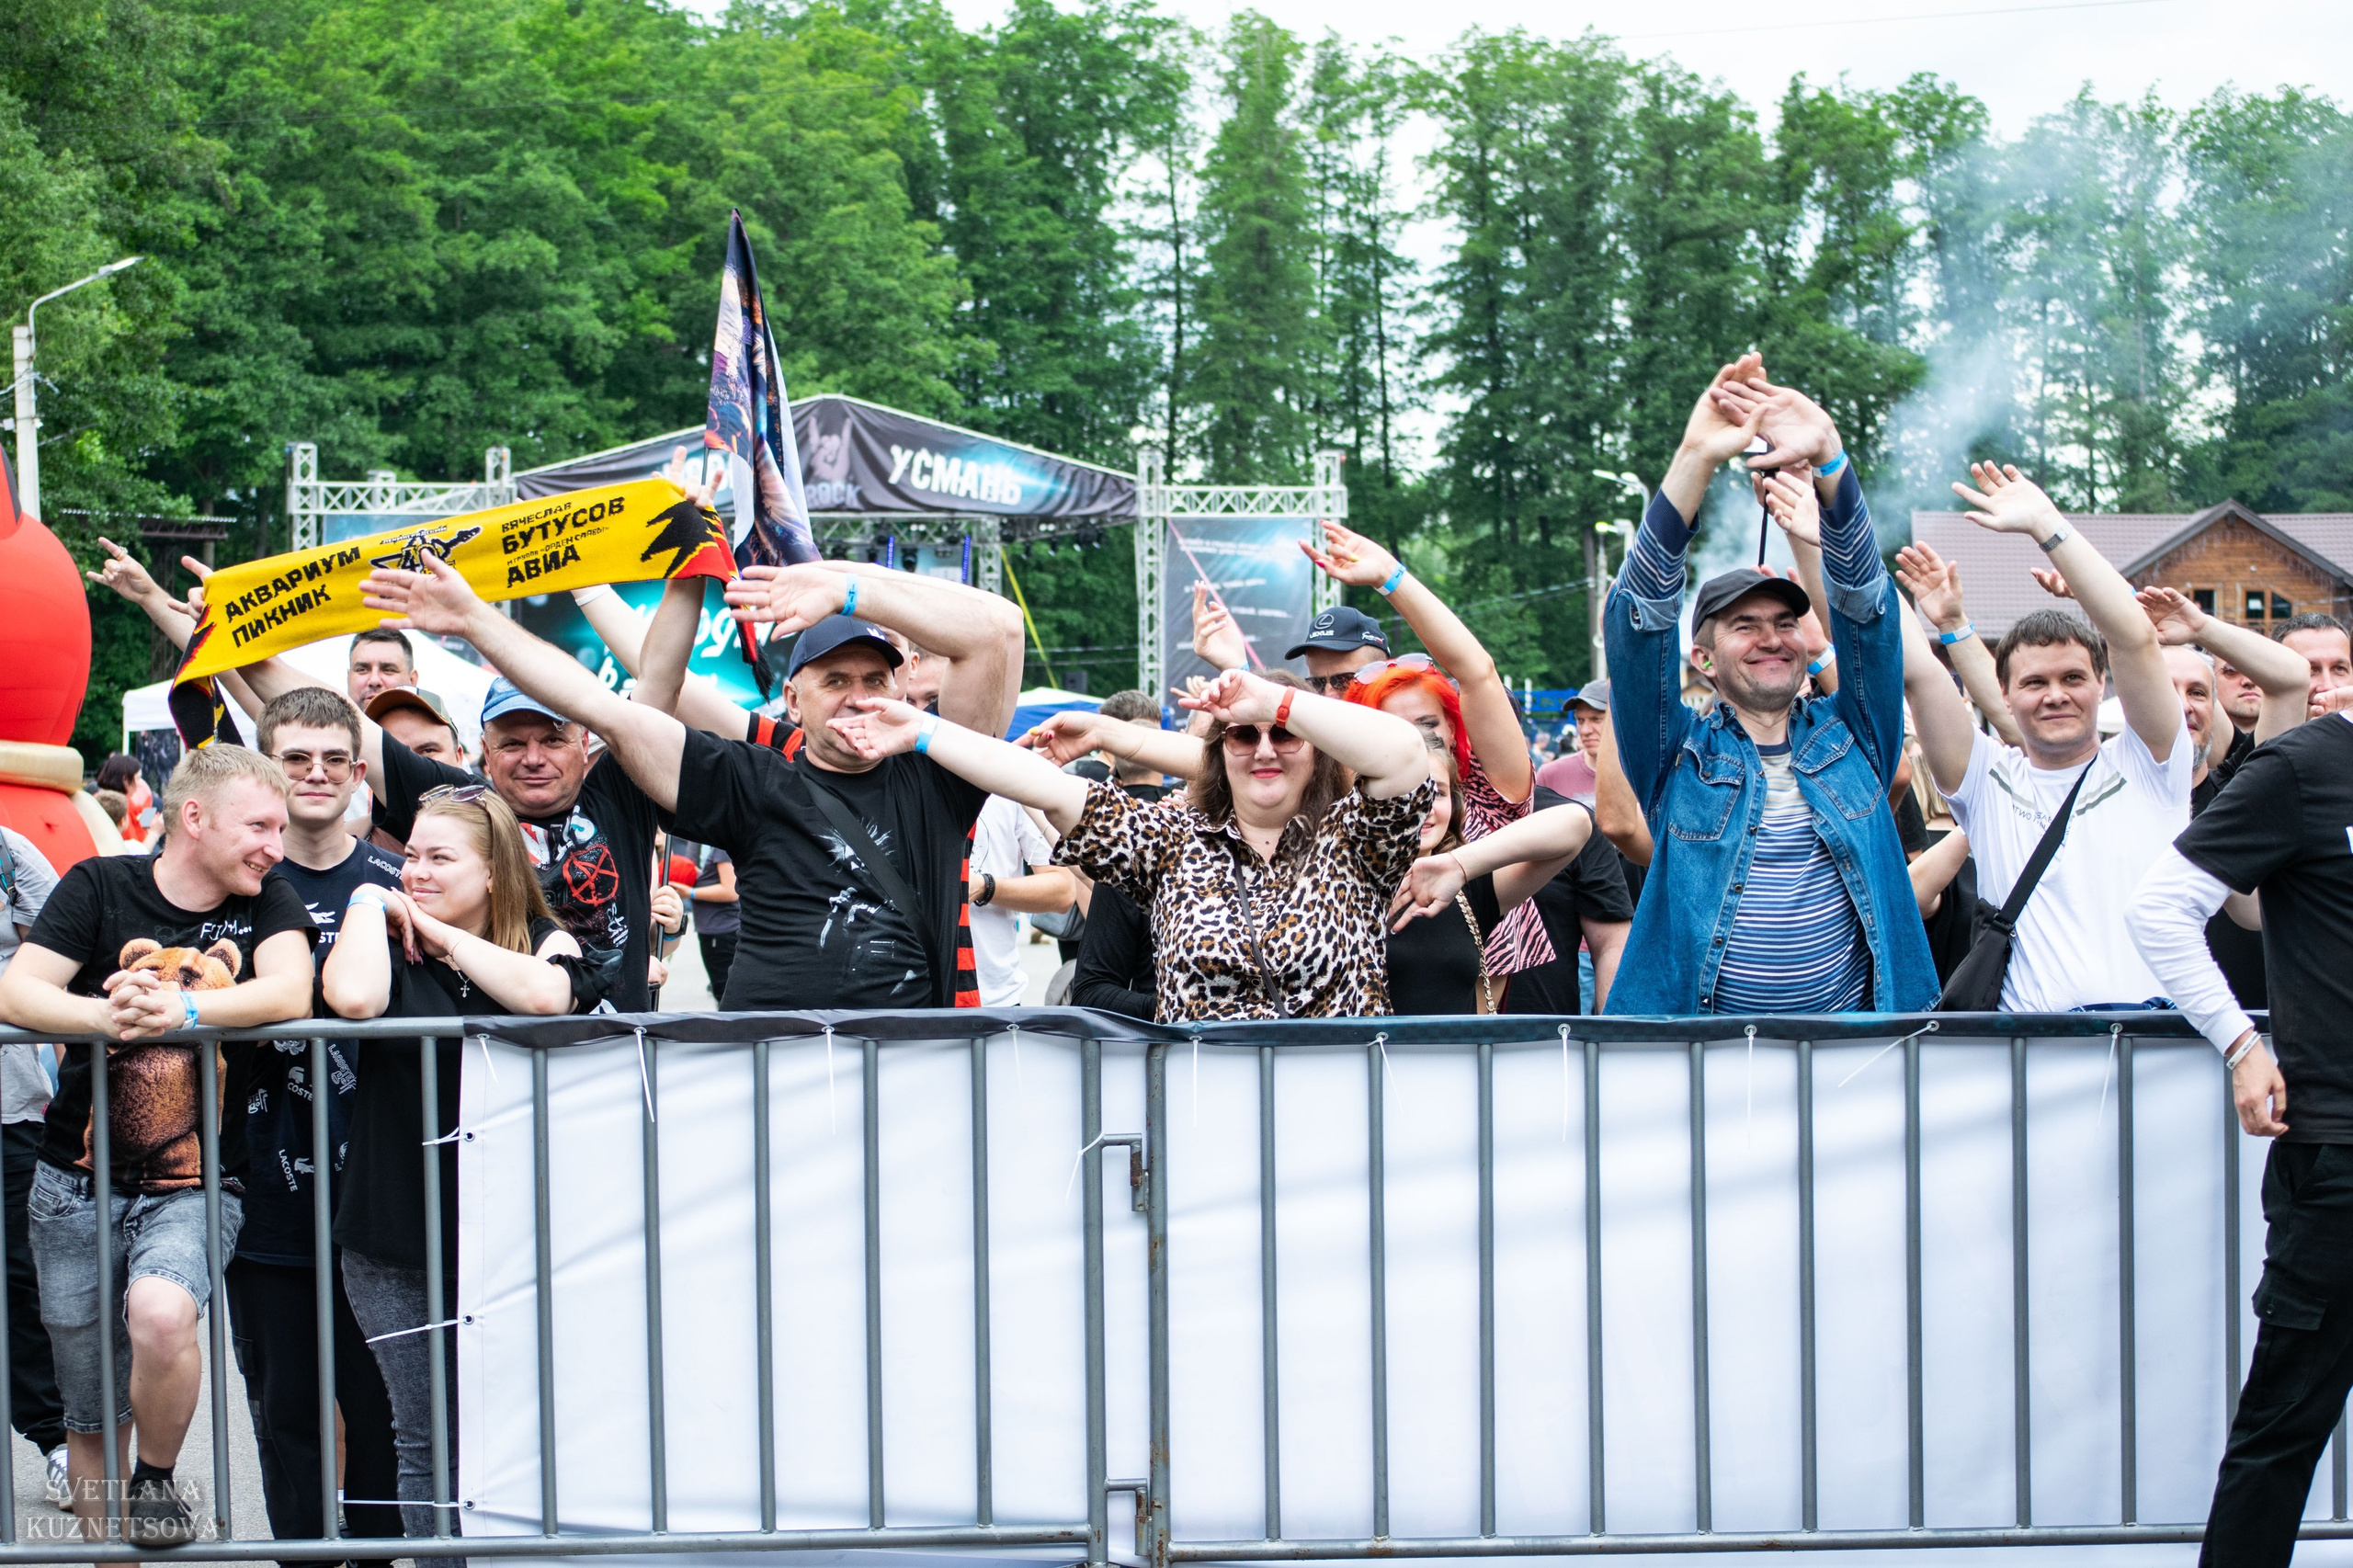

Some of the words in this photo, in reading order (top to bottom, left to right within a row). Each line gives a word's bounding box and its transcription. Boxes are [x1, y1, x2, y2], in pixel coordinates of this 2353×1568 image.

[805, 483, 863, 509] ROCK
[888, 444, 1022, 506] УСМАНЬ
[501, 502, 572, 533] ВЯЧЕСЛАВ
[501, 496, 625, 555] БУТУСОВ
[225, 547, 361, 623] АКВАРИУМ
[506, 544, 581, 588] АВИА
[232, 584, 332, 648] ПИКНИК
[287, 1082, 313, 1101] COSTE
[278, 1149, 299, 1192] LACOSTE
